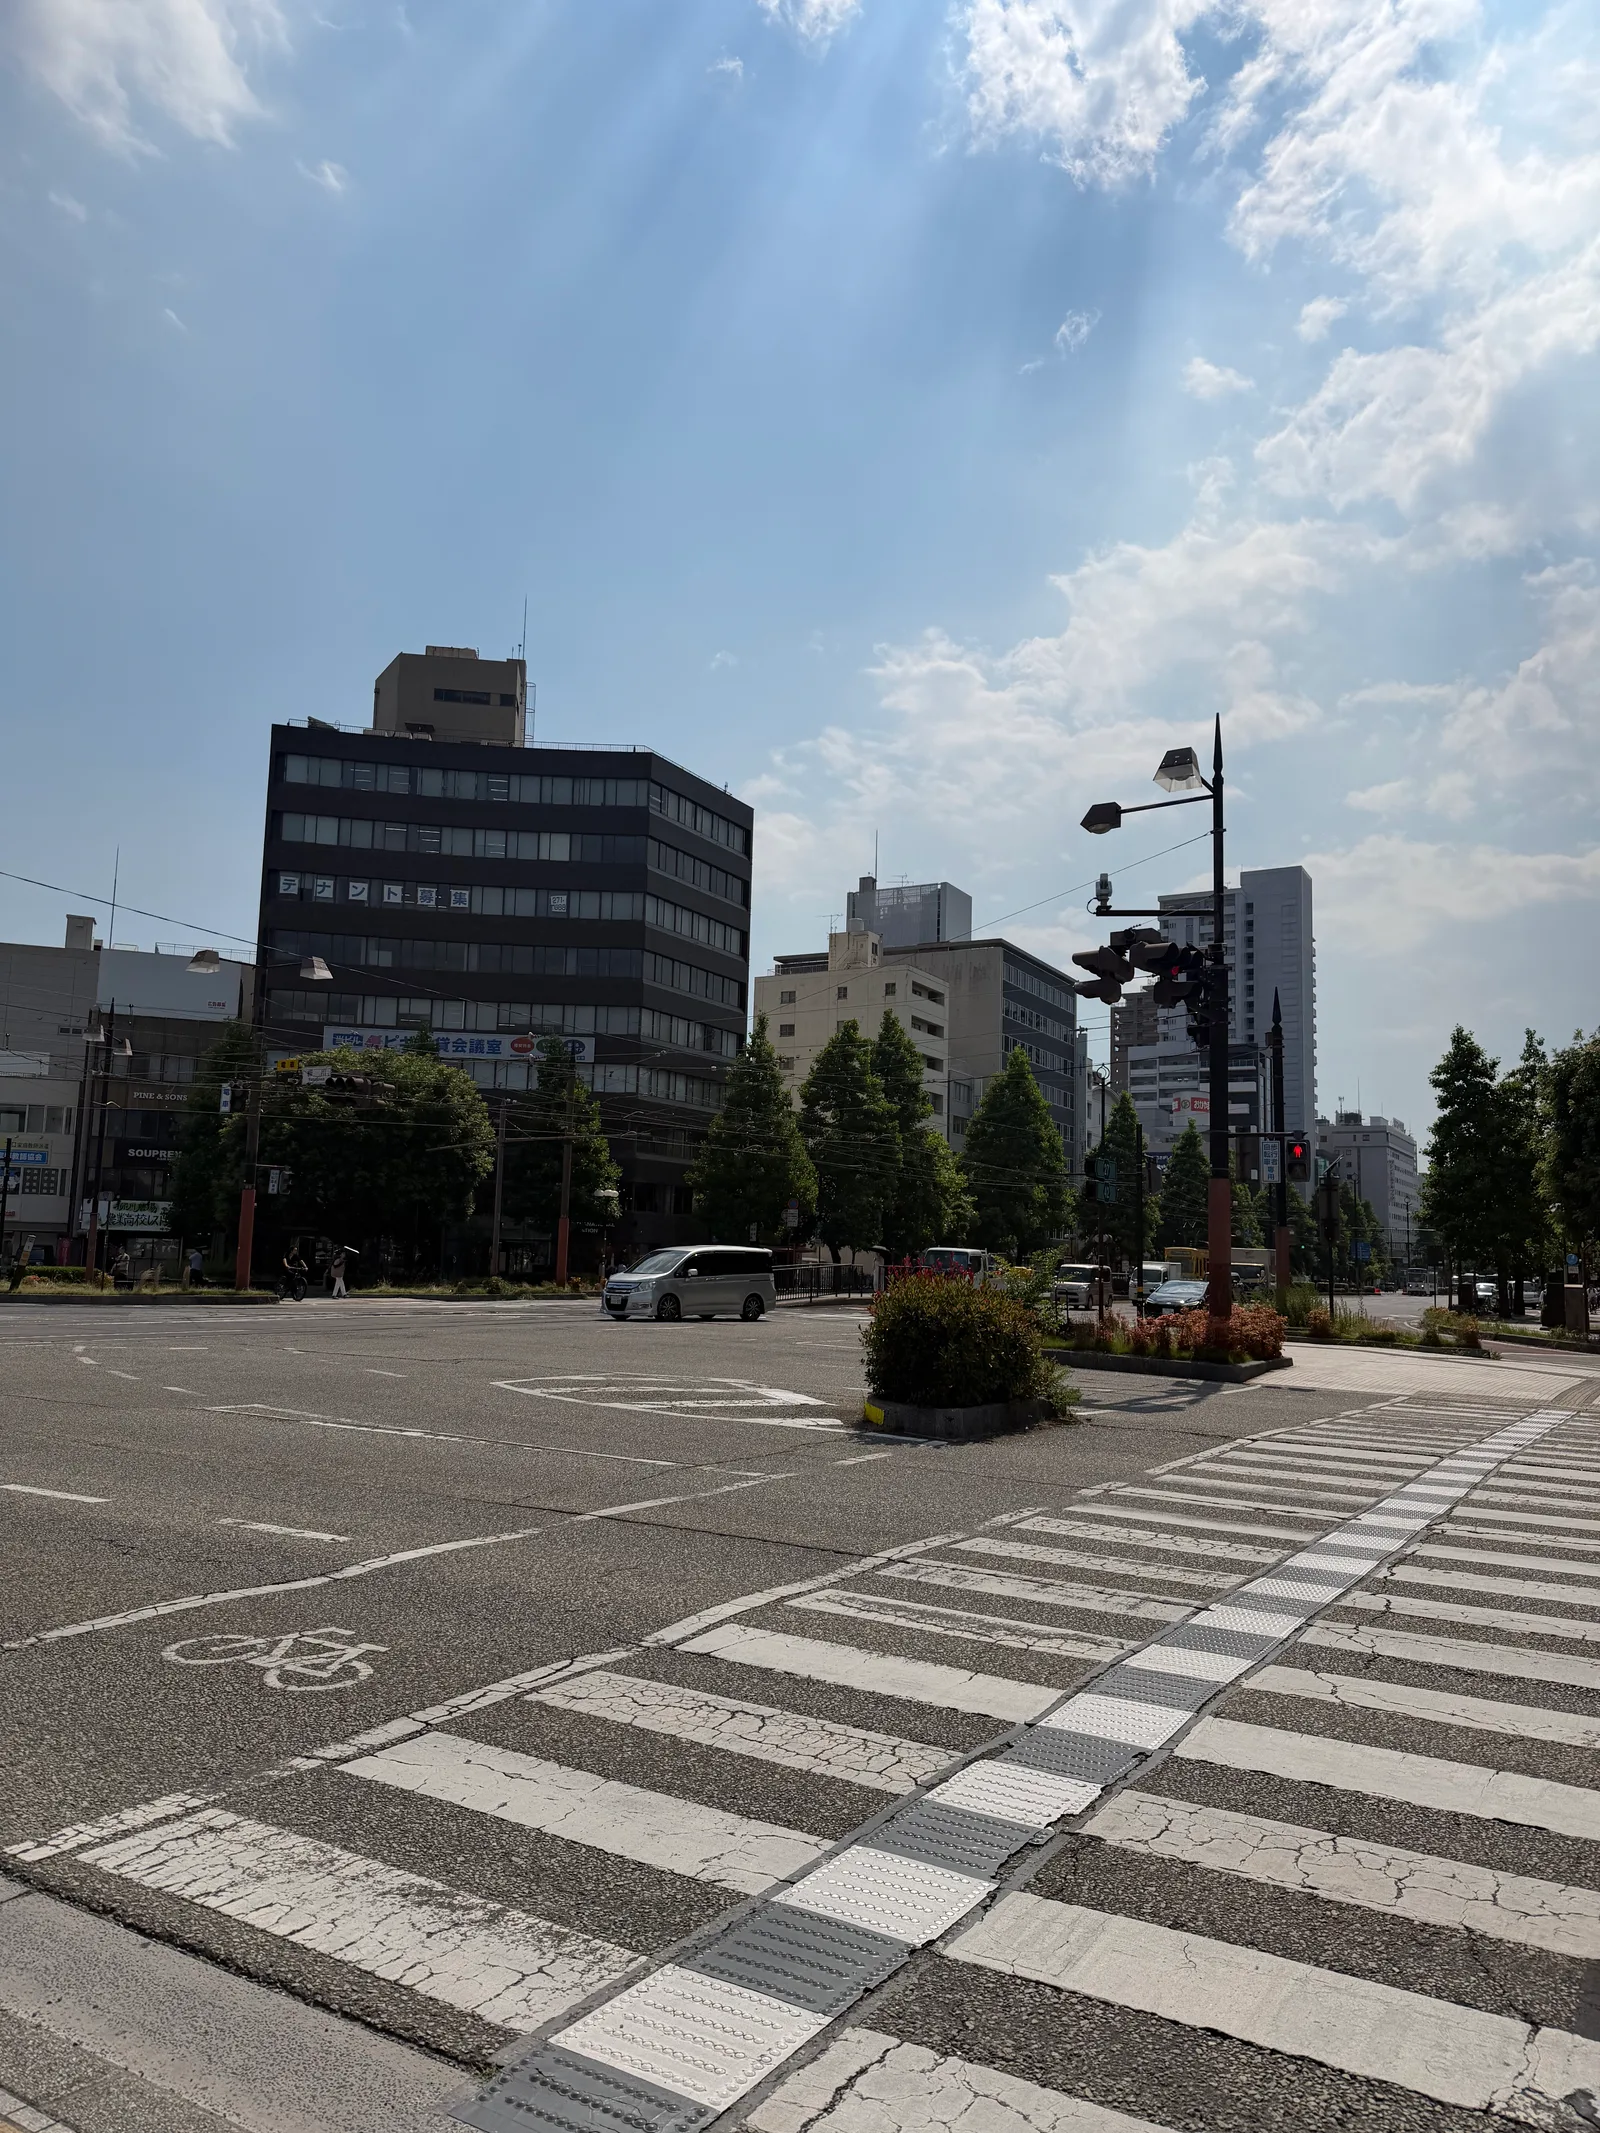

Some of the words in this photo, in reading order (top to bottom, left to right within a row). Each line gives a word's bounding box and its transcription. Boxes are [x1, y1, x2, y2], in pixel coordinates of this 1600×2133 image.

[281, 878, 468, 907] テナント募集
[133, 1092, 155, 1100] PINE
